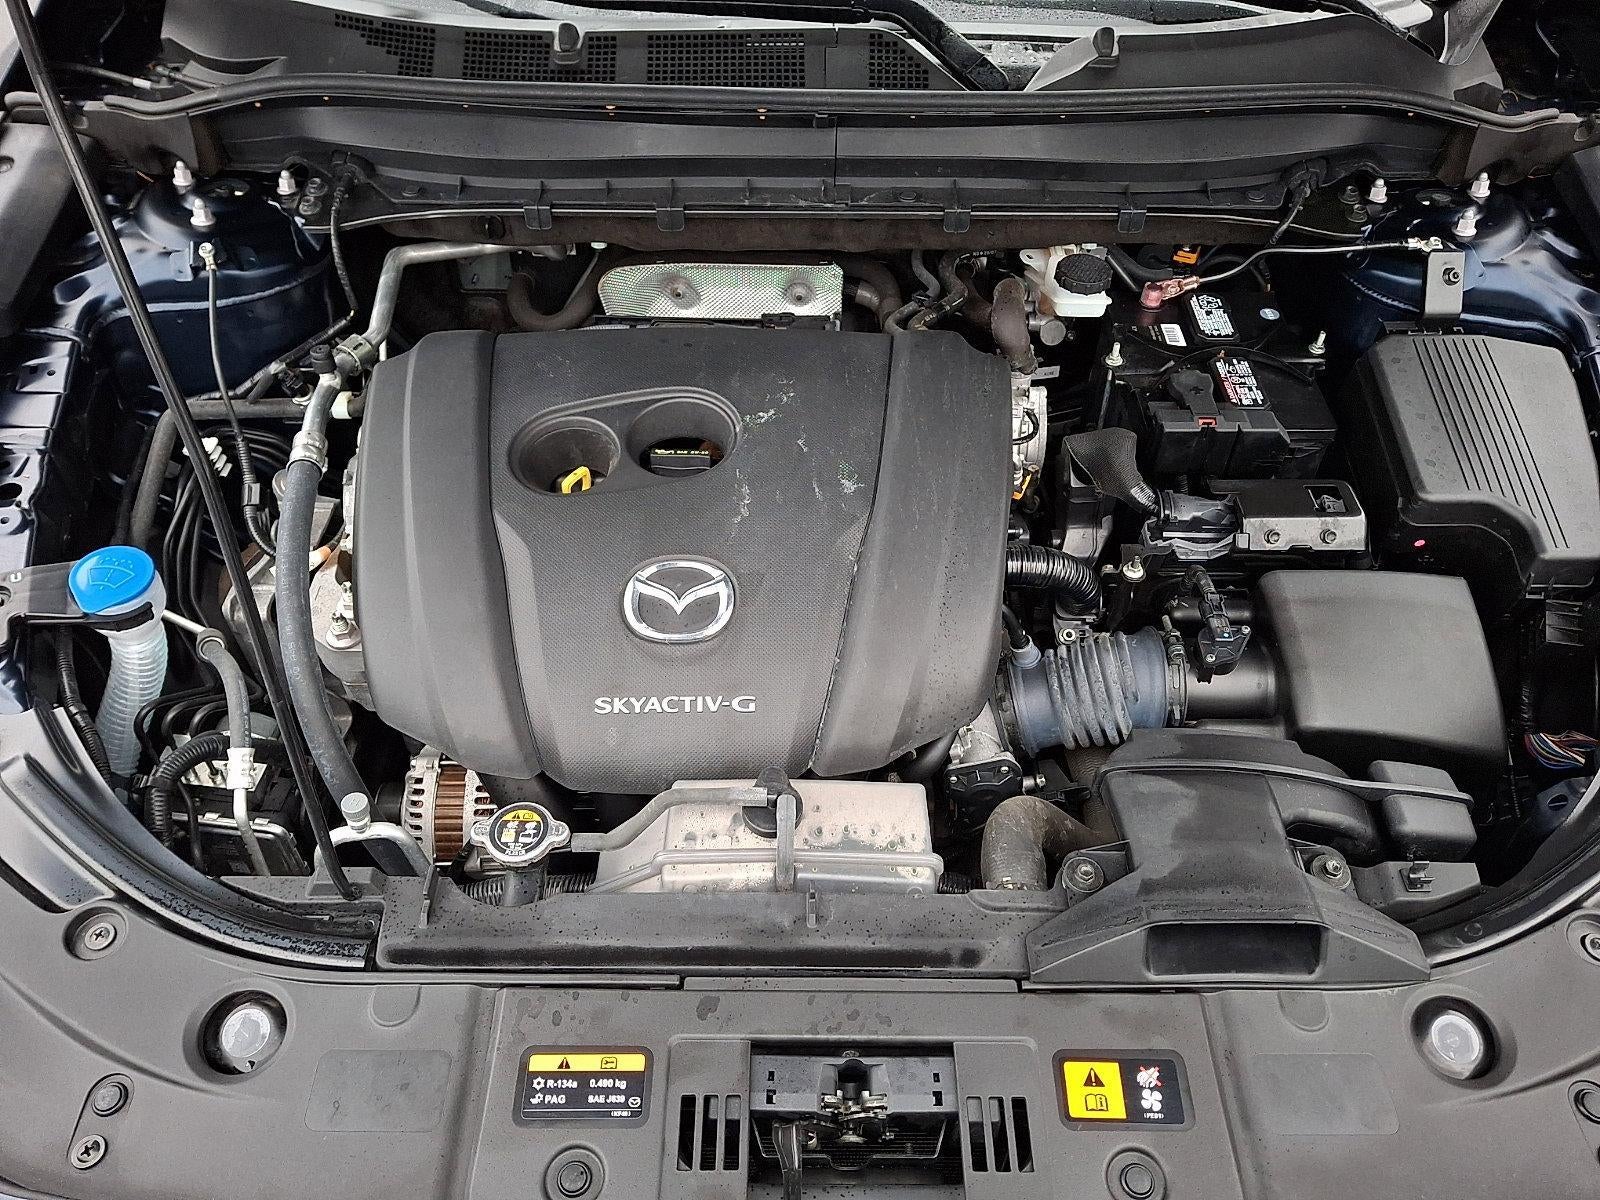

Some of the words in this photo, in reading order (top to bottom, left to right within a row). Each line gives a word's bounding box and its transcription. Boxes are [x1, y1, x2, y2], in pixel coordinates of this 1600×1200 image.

[594, 695, 757, 714] SKYACTIV-G
[546, 1079, 578, 1089] R-134a
[614, 1079, 627, 1090] kg
[544, 1094, 566, 1104] PAG
[587, 1094, 606, 1104] SAE
